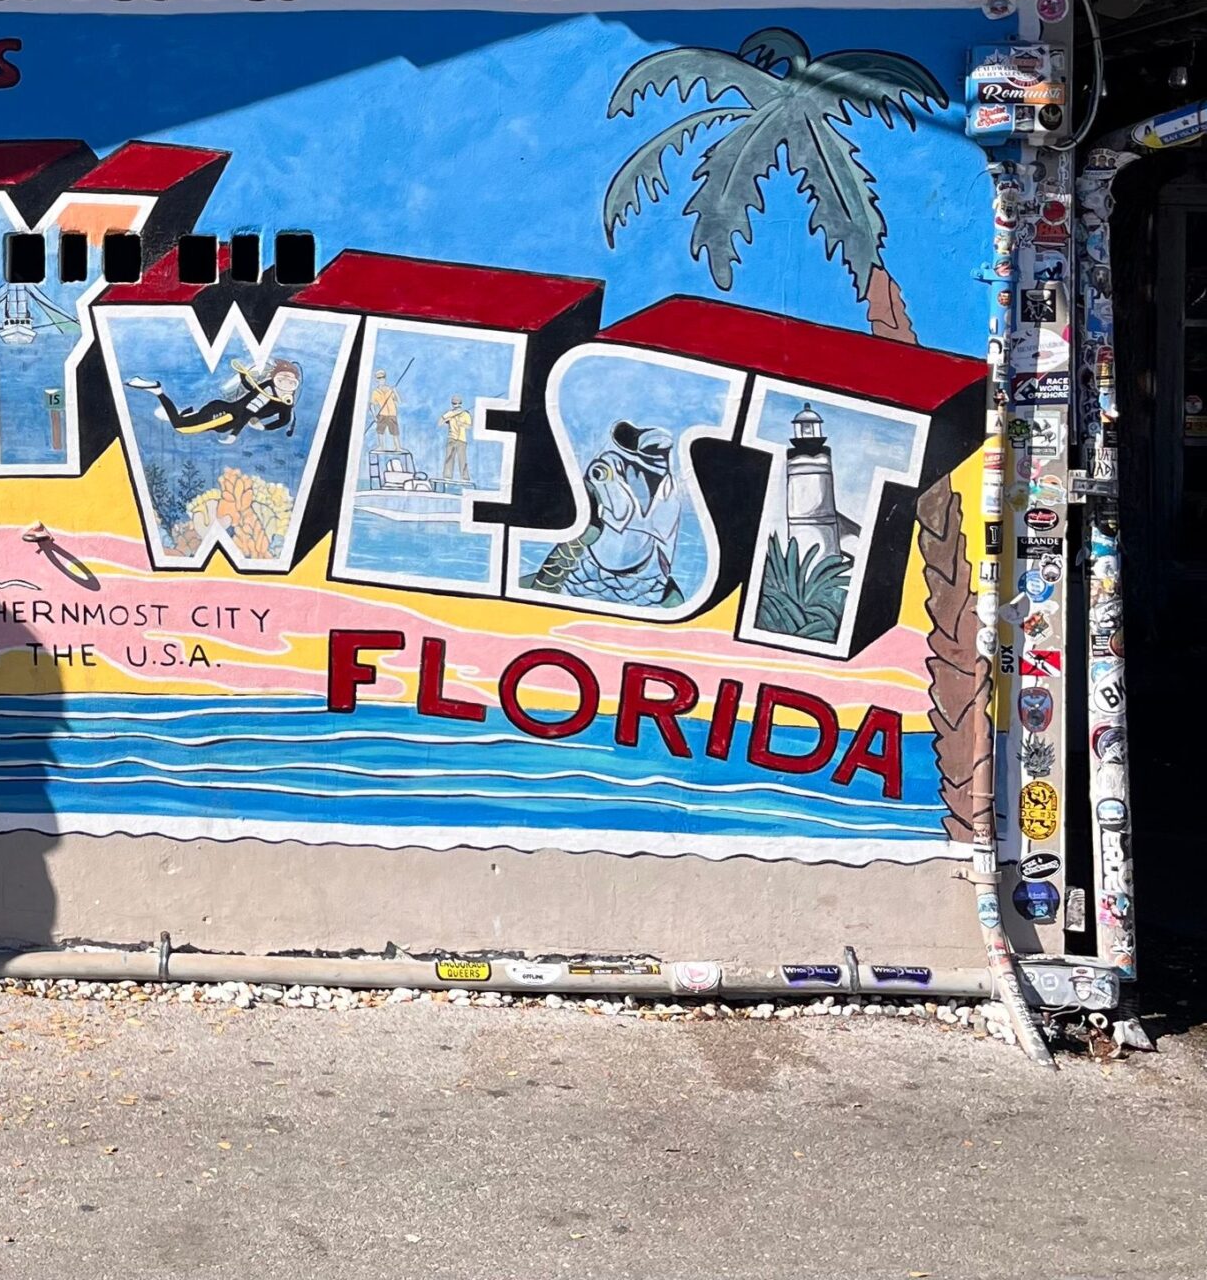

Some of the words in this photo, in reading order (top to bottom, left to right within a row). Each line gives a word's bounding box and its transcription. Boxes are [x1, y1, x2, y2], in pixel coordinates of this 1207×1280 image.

[1046, 377, 1069, 385] RACE
[1028, 391, 1068, 399] OFFSHORE
[92, 300, 931, 659] WEST
[1021, 537, 1060, 545] GRANDE
[192, 606, 271, 632] CITY
[26, 643, 96, 666] THE
[127, 643, 222, 667] U.S.A.
[328, 629, 903, 799] FLORIDA
[447, 969, 480, 978] QUEERS
